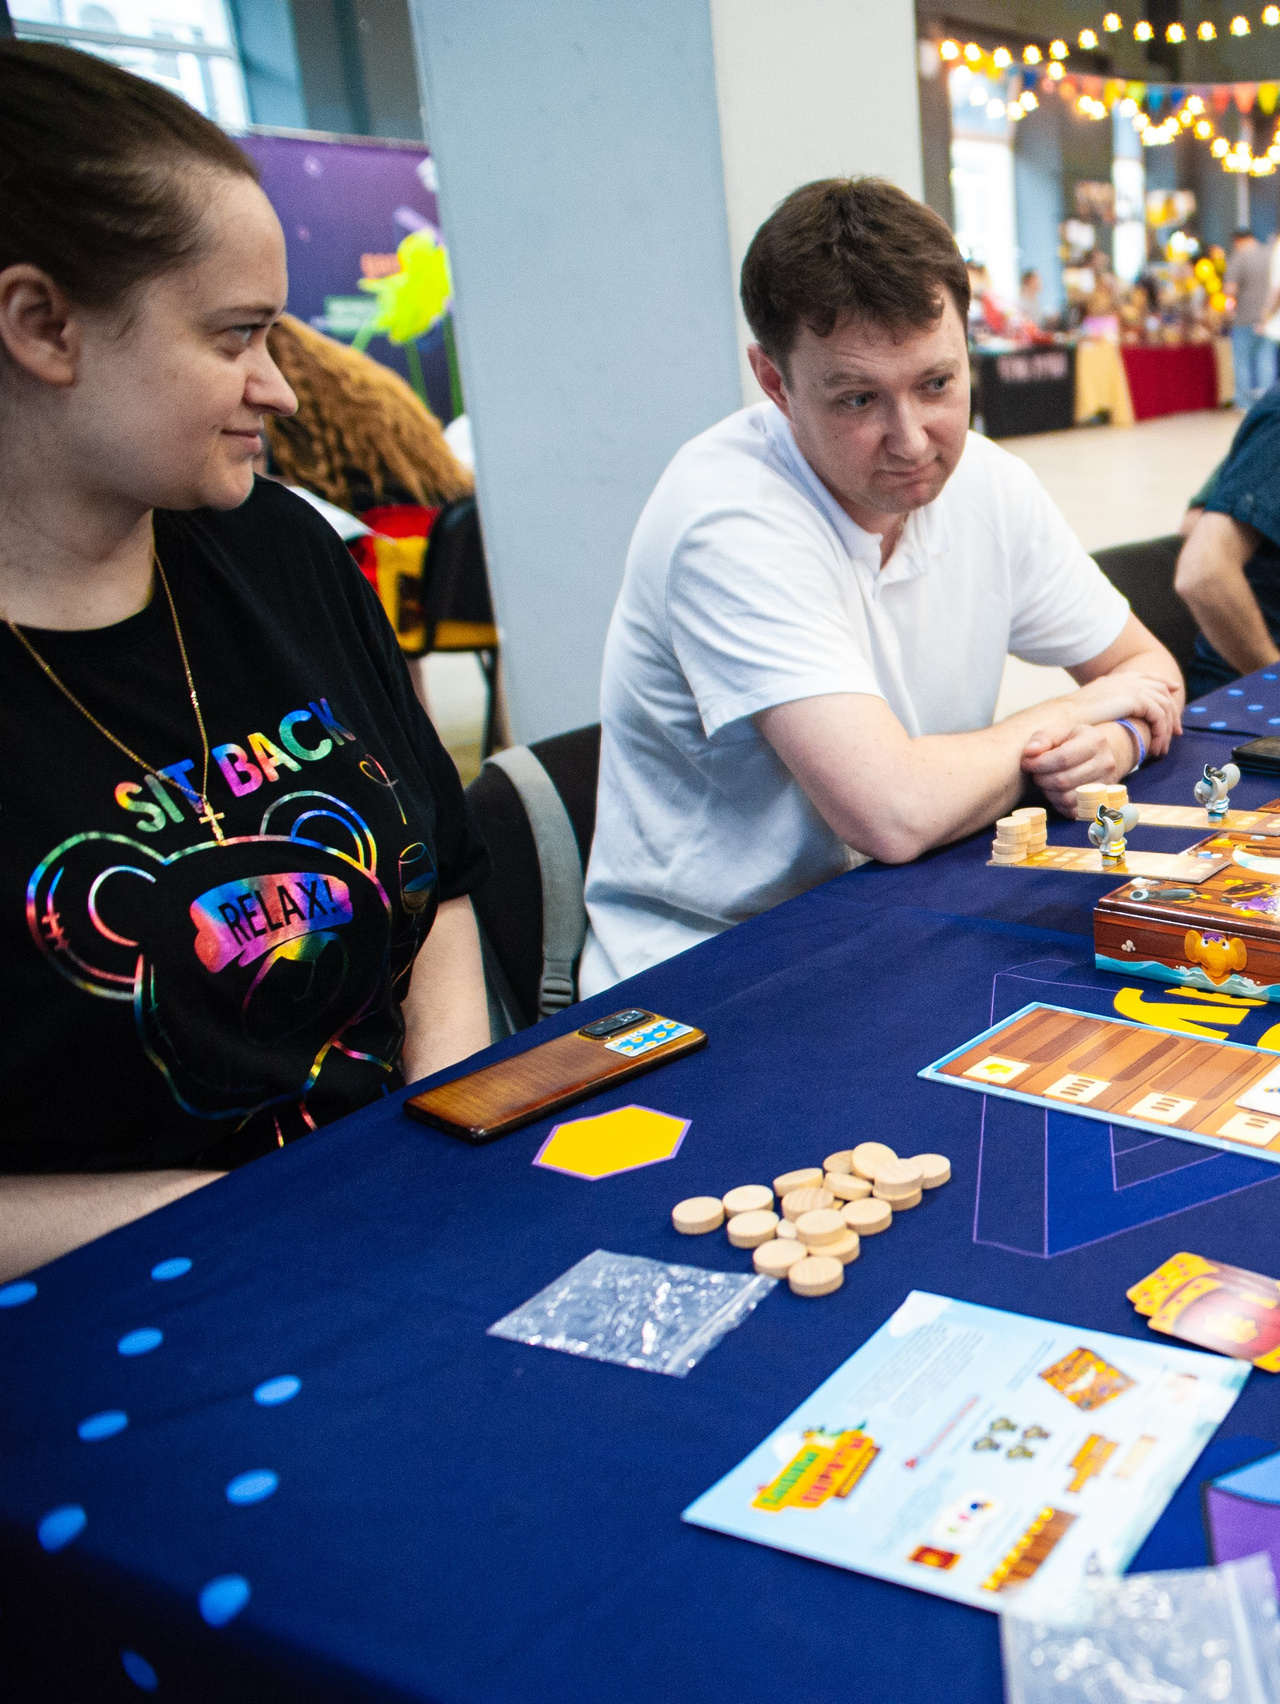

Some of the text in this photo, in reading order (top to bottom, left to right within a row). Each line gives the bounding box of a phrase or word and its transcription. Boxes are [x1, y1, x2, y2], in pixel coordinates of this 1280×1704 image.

[114, 698, 356, 832] SIT BACK
[218, 879, 337, 946] RELAX!
